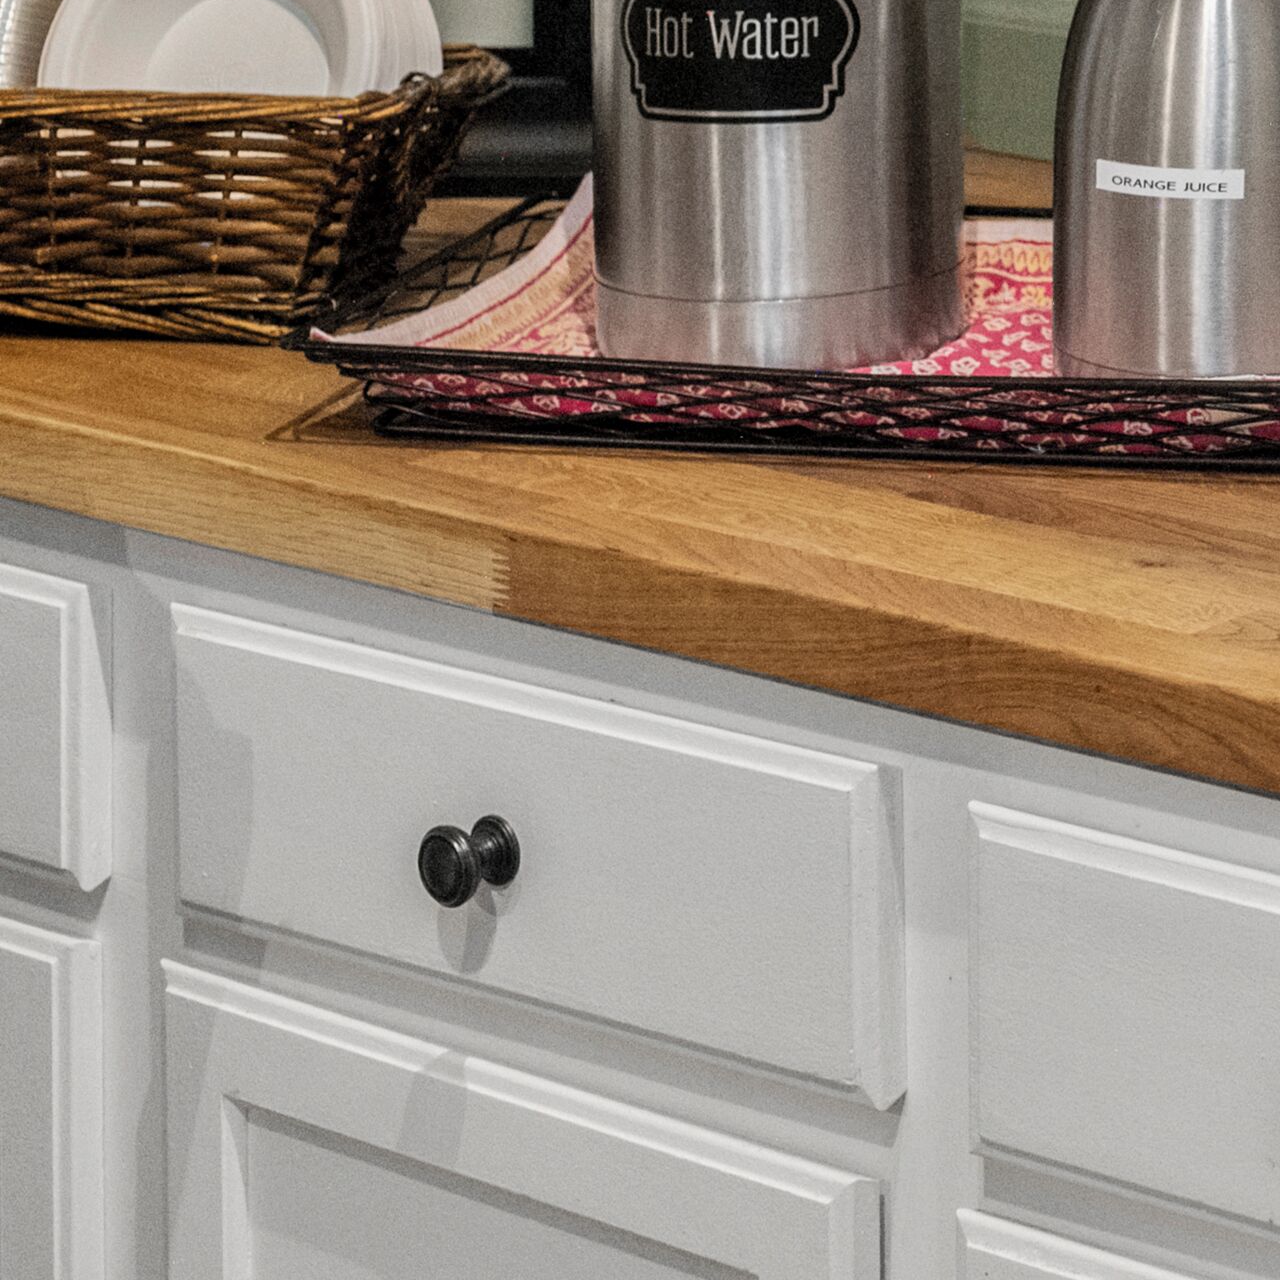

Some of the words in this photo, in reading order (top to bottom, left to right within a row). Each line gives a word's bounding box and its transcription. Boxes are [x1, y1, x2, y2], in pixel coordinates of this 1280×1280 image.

[645, 6, 695, 59] Hot
[706, 9, 820, 60] Water
[1111, 174, 1177, 192] ORANGE
[1183, 181, 1229, 194] JUICE
